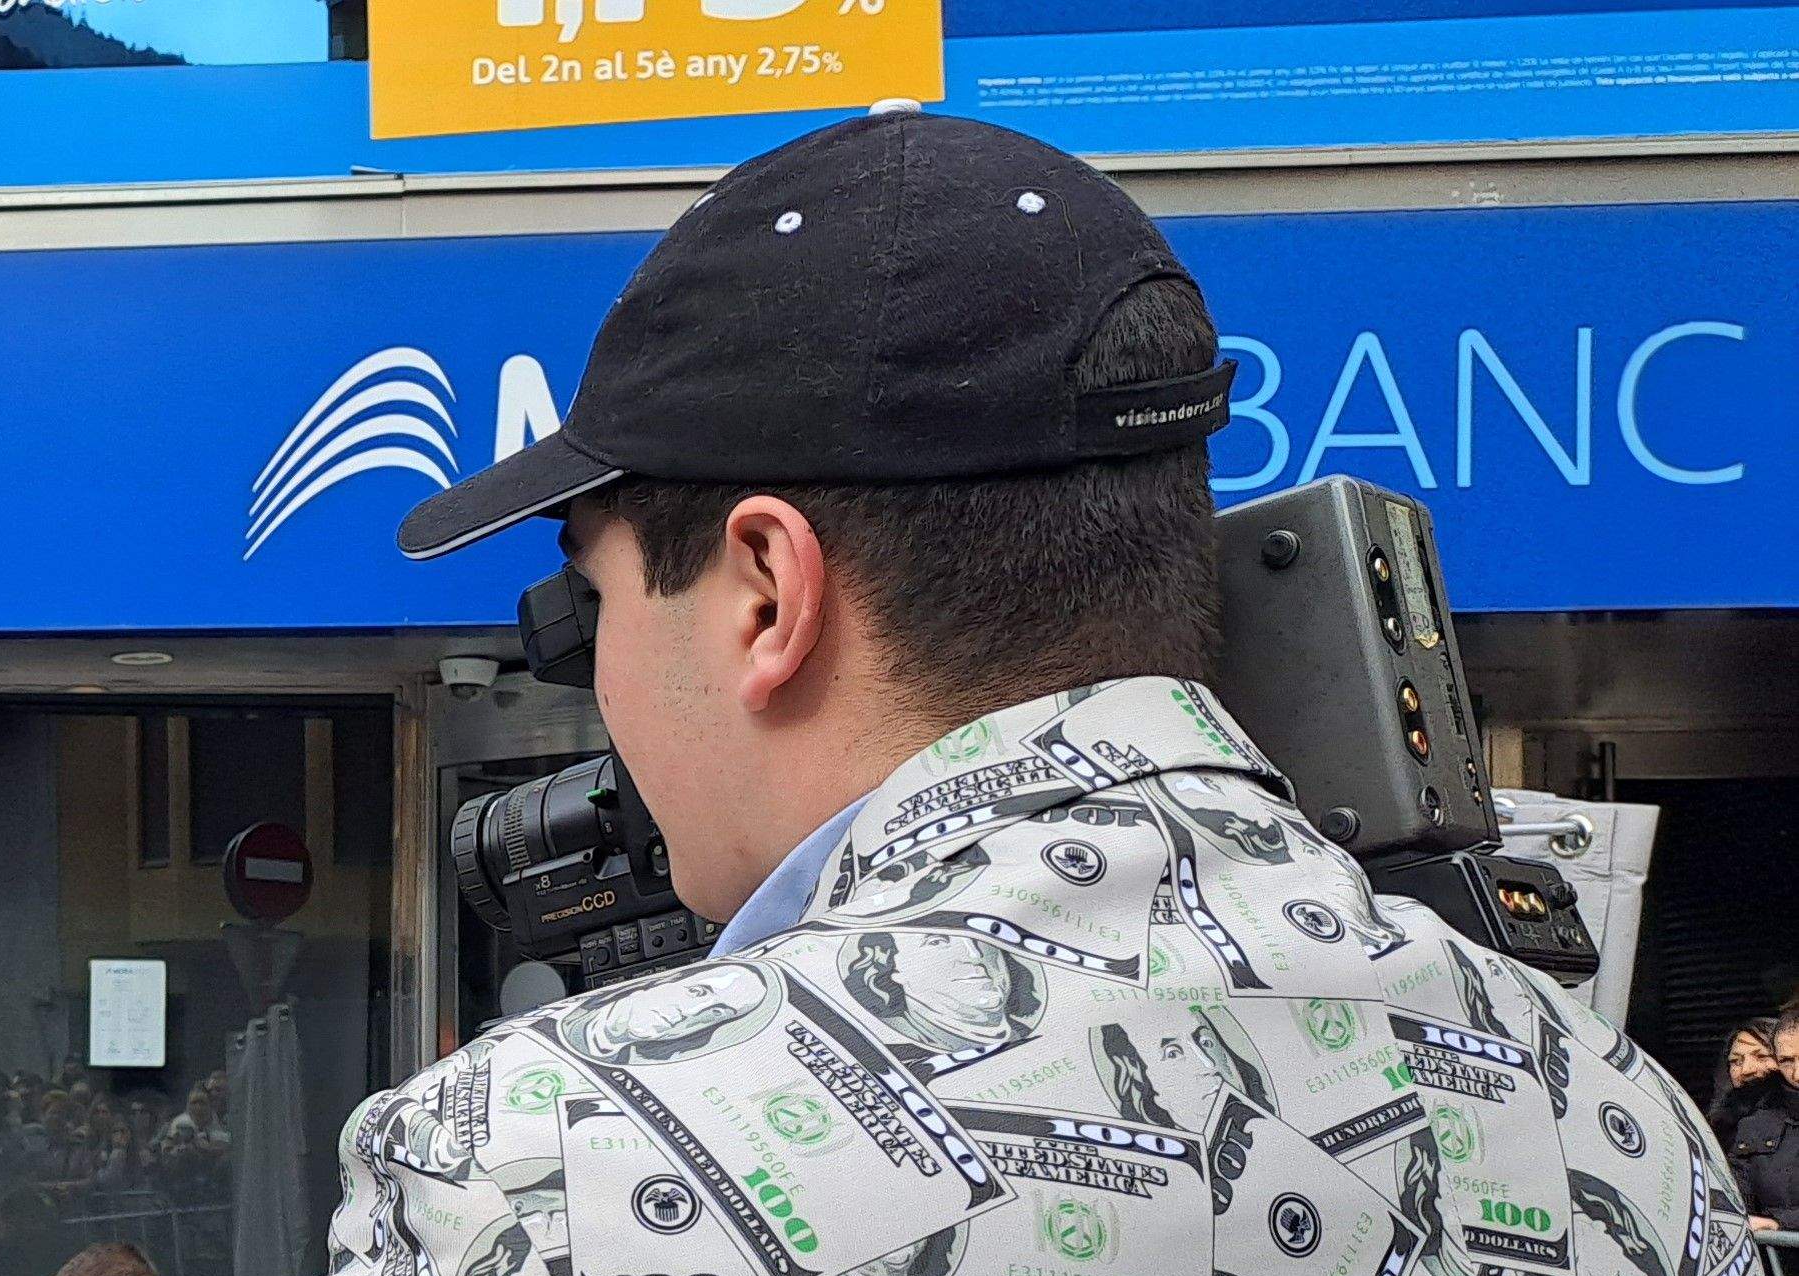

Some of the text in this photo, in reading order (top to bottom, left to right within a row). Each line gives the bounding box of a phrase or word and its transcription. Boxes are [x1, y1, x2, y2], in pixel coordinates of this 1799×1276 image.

[473, 45, 844, 85] Del 2n al 5è any 2,75%
[1421, 1026, 1525, 1065] 100
[1051, 1119, 1186, 1157] 100
[741, 1168, 819, 1254] 100
[1479, 1198, 1552, 1233] 100
